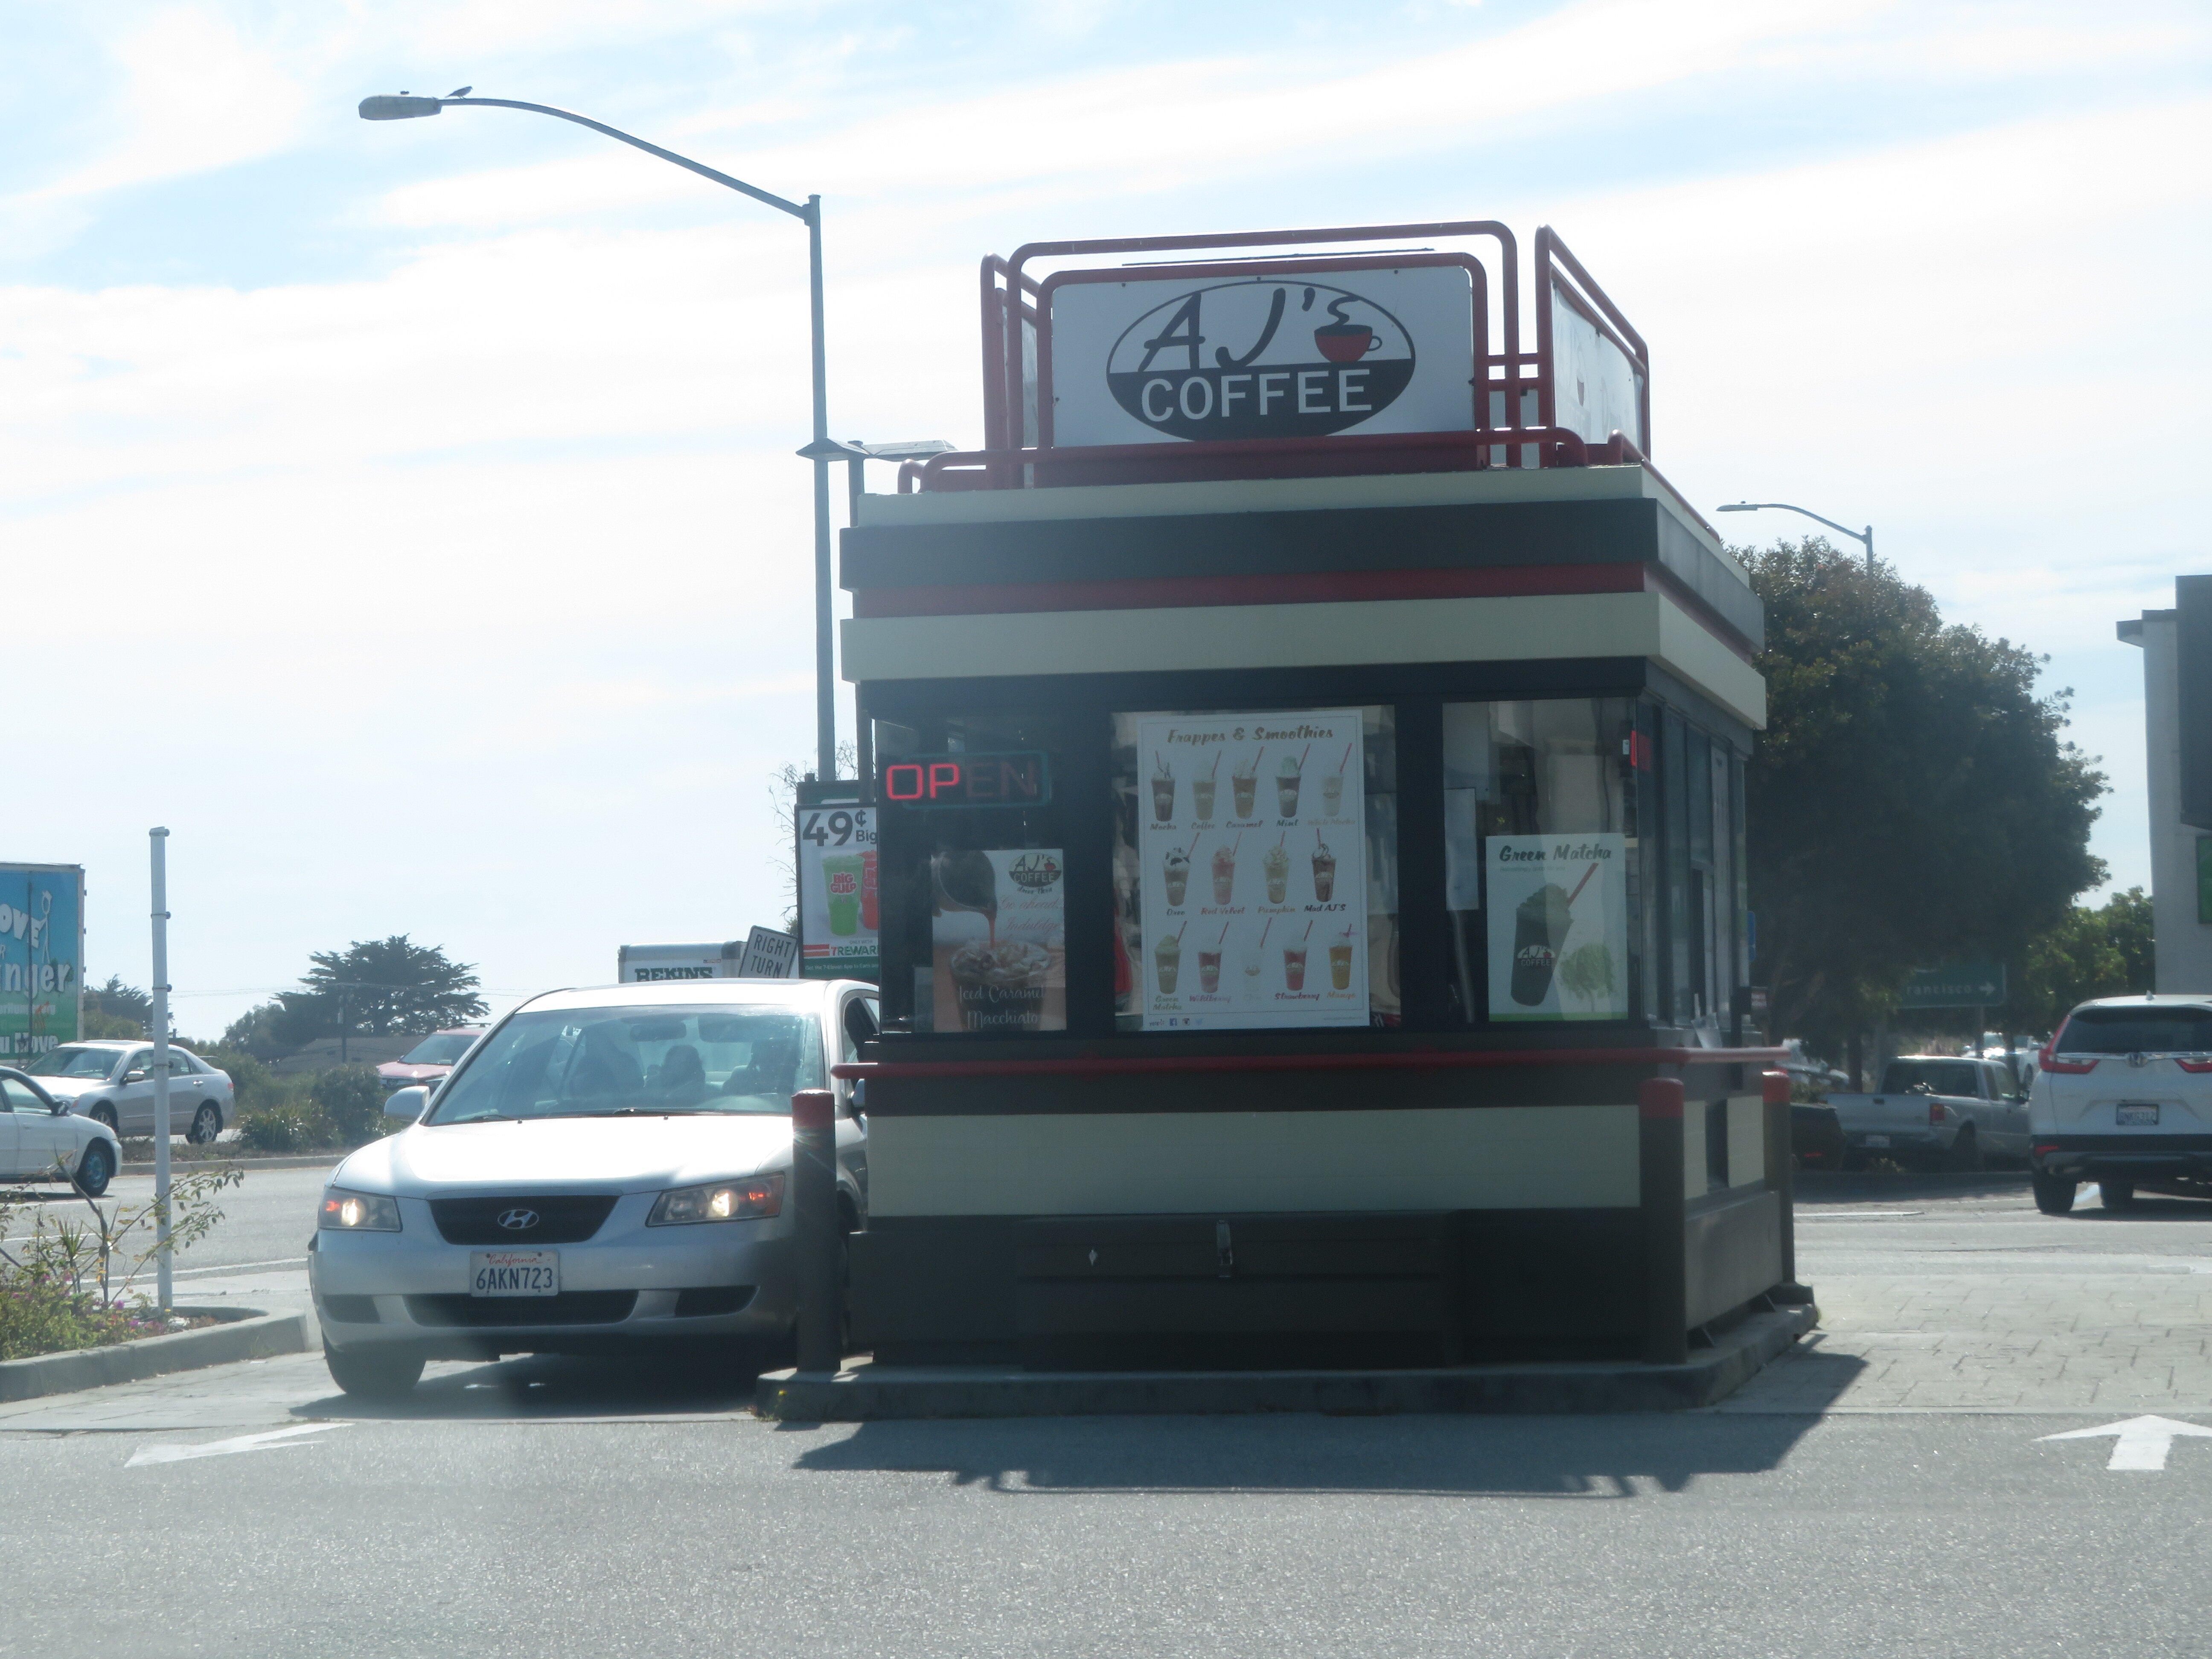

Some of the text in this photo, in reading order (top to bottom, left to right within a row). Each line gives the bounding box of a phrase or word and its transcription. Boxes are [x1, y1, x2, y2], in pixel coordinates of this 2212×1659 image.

[1141, 369, 1372, 422] COFFEE
[1167, 725, 1334, 745] Frappes & Smoothies
[886, 762, 1036, 800] OPEN
[1150, 822, 1177, 830] Mocha
[1190, 822, 1215, 830] Coffee
[1226, 820, 1263, 829] Caramel
[1276, 819, 1298, 827] Mint
[856, 830, 877, 845] Big
[1499, 843, 1612, 862] Green Matcha
[1014, 872, 1055, 883] COFFEE
[830, 883, 856, 894] GULP
[1257, 906, 1296, 914] Pumpkin
[753, 934, 792, 958] RIGHT
[831, 946, 878, 956] 7REWAR
[750, 955, 783, 978] TURN
[959, 985, 1045, 1004] Iced Caramel
[1274, 992, 1321, 1001] Strawberry
[1326, 991, 1356, 1000] Mango
[966, 1010, 1039, 1029] Macchiato
[489, 1254, 543, 1267] California
[476, 1268, 553, 1290] 6AKN723
